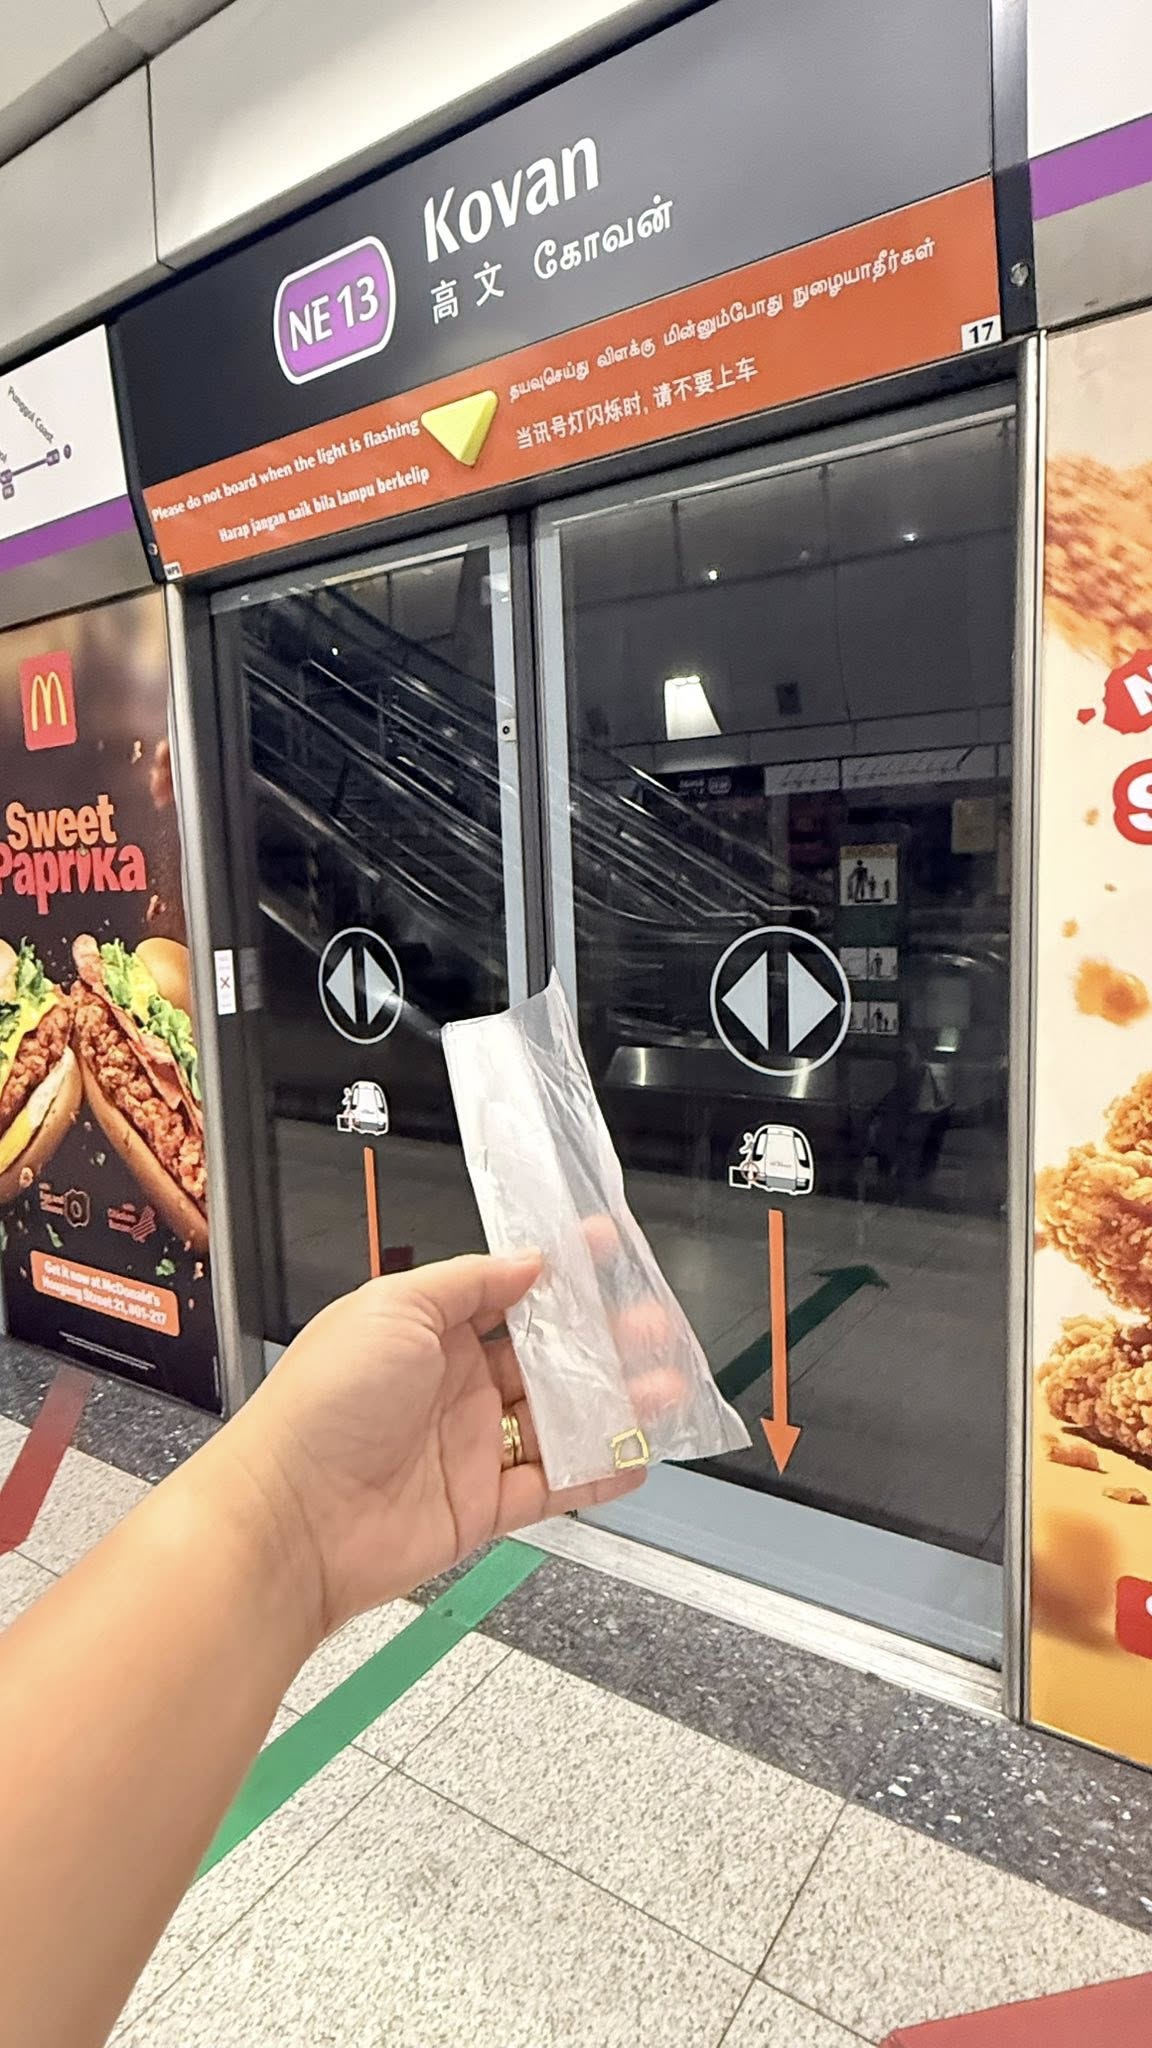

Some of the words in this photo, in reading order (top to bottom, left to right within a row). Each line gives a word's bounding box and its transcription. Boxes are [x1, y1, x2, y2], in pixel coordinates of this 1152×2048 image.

[422, 136, 600, 264] Kovan
[533, 194, 674, 281] கோவன்
[287, 295, 334, 353] NE
[335, 275, 380, 330] 13
[430, 261, 505, 324] 高文
[508, 359, 589, 403] தயவுசெய்து
[596, 340, 656, 369] விளக்கு
[663, 293, 783, 347] மின்னும்போது
[792, 237, 937, 310] நுழையாதீர்கள்
[969, 320, 994, 344] 17
[151, 503, 185, 522] Please
[186, 494, 201, 508] do
[203, 489, 222, 506] not
[223, 472, 257, 498] board
[259, 464, 293, 485] when
[294, 456, 316, 473] the
[317, 442, 347, 467] light
[349, 437, 362, 453] is
[363, 420, 420, 449] flashing
[218, 522, 251, 543] Harap
[250, 511, 287, 537] jangan
[288, 503, 313, 522] naik
[313, 494, 336, 513] bila
[336, 483, 375, 507] lampu
[376, 465, 430, 495] berkelip
[5, 794, 118, 851] Sweet
[44, 1260, 61, 1278] Get
[61, 1263, 70, 1280] it
[70, 1270, 90, 1286] now
[90, 1274, 101, 1289] at
[101, 1277, 160, 1307] McDonald's
[82, 1287, 113, 1309] Street
